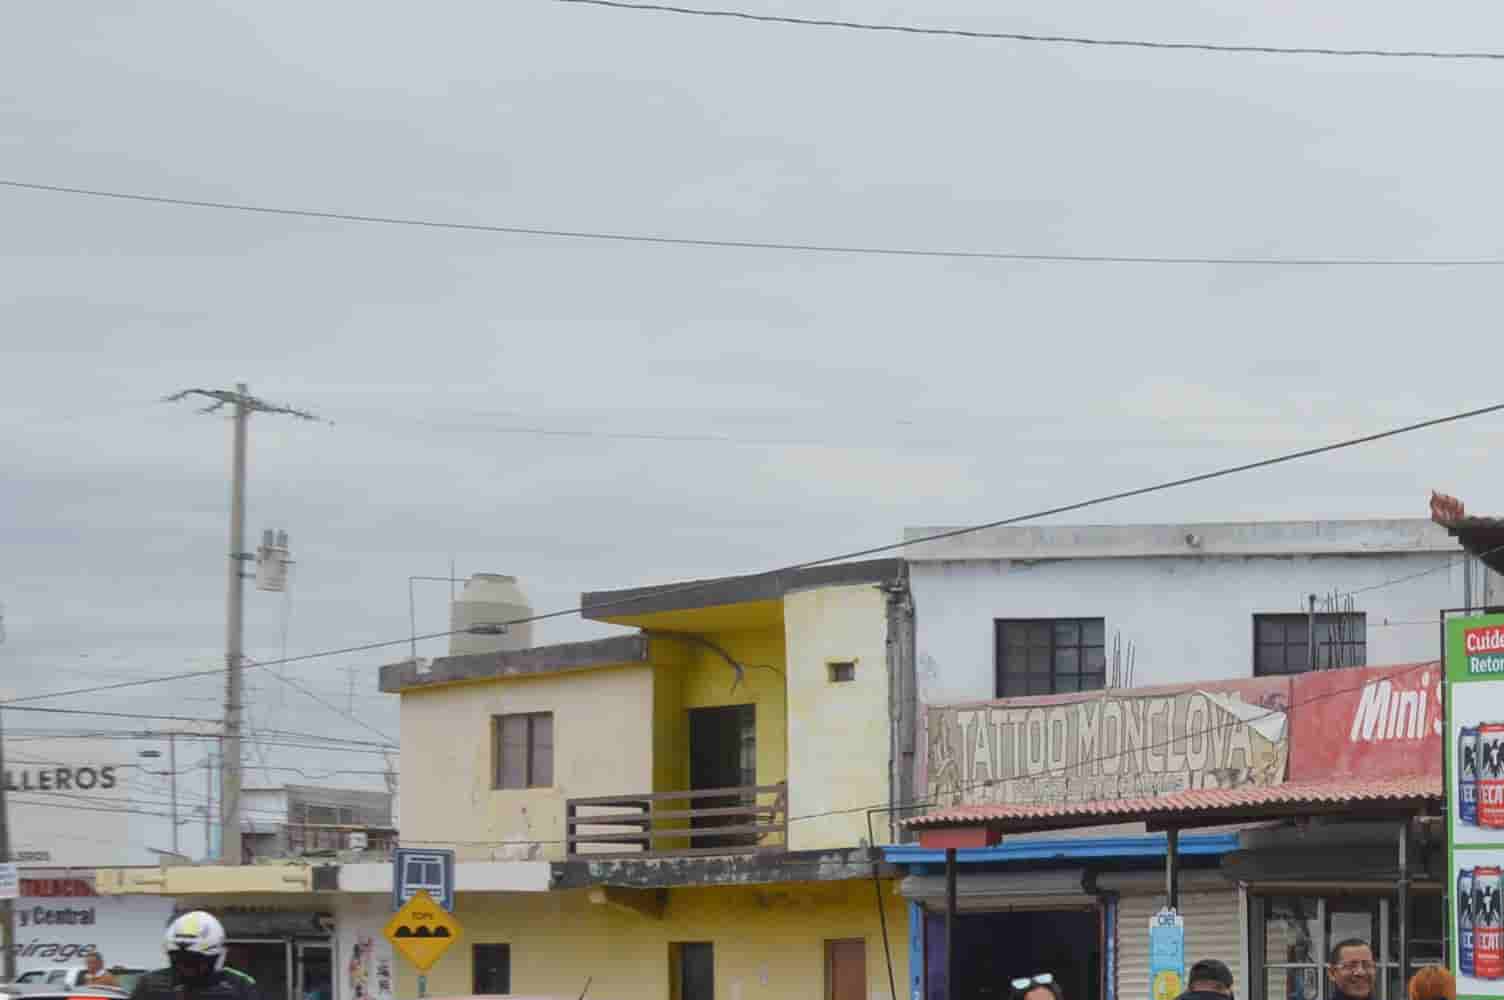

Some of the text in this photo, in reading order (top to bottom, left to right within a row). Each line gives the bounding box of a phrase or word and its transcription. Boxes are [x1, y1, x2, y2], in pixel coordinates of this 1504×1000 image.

[957, 694, 1251, 783] TATTOO MONCLOVA
[1350, 671, 1428, 742] Mini
[33, 906, 96, 925] Central
